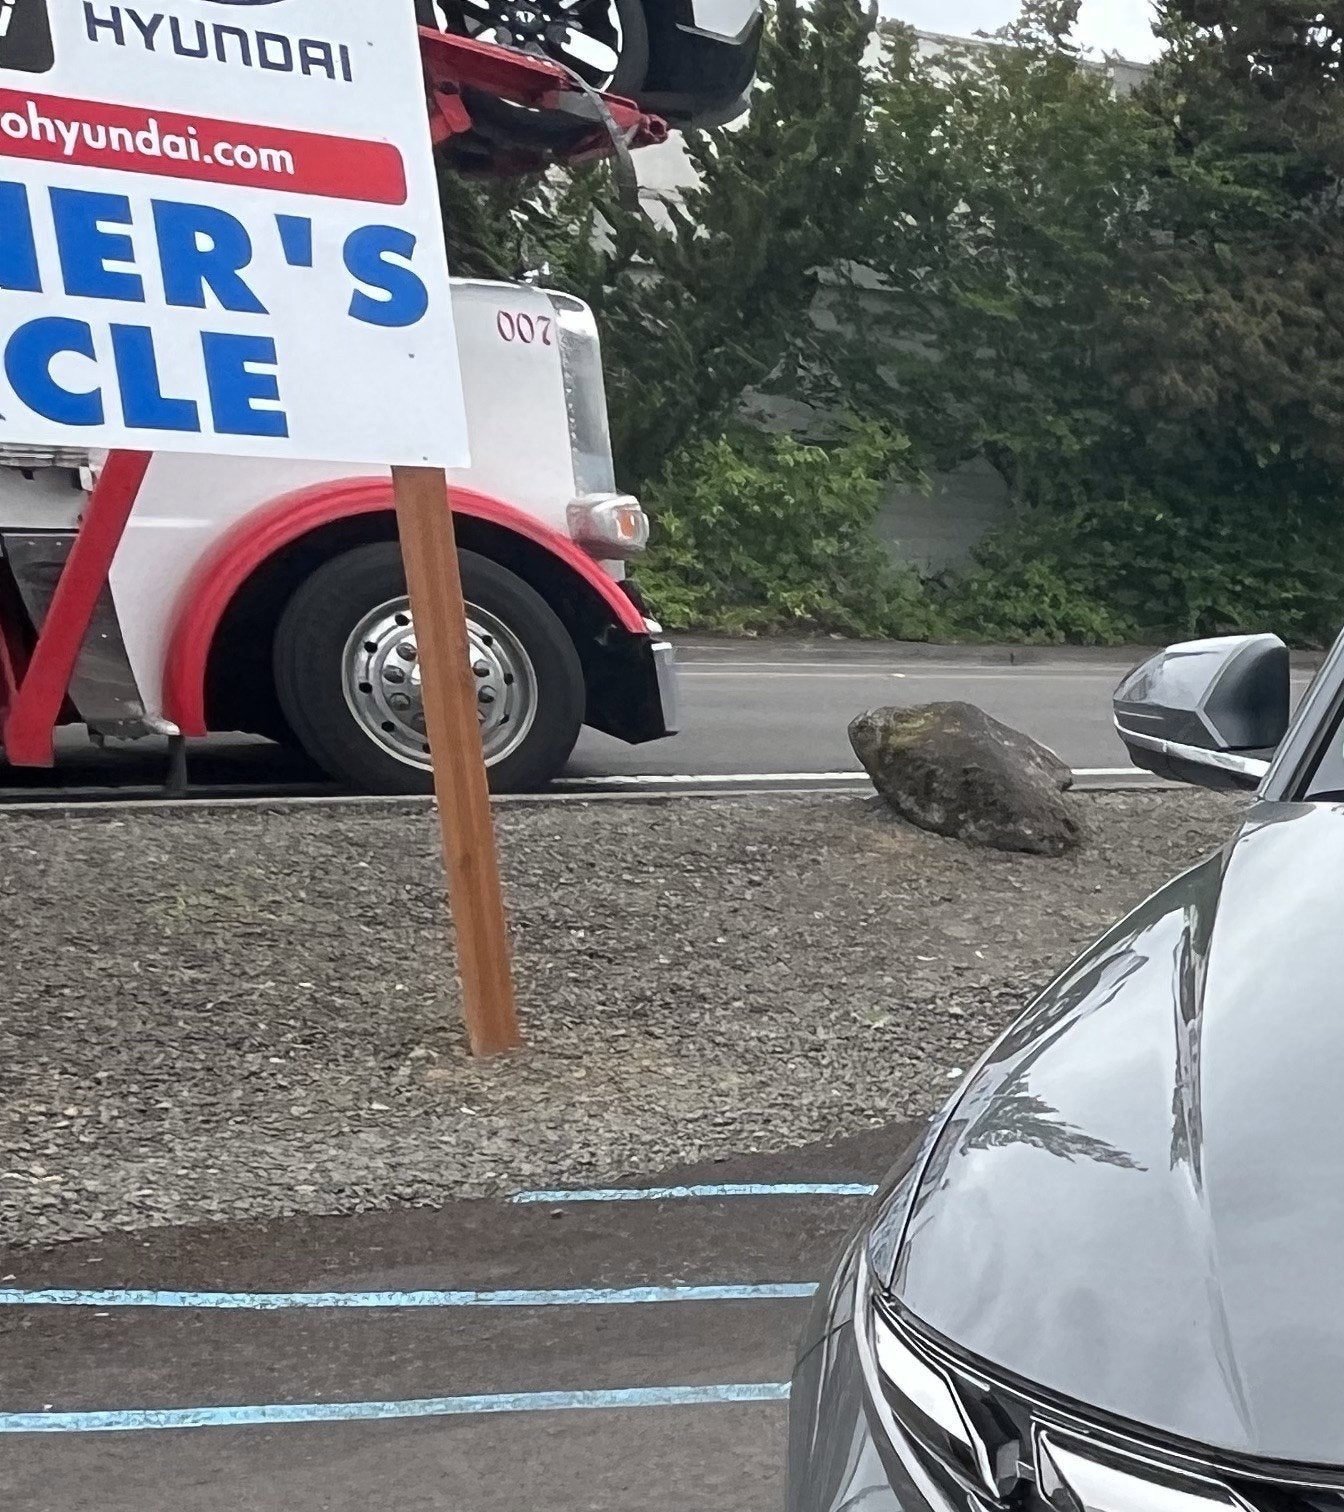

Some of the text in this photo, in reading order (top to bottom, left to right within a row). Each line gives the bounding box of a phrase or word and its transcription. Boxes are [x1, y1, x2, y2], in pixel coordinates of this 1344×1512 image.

[83, 1, 352, 82] HYUNDAI
[497, 310, 551, 346] 007
[0, 316, 290, 438] CLE
